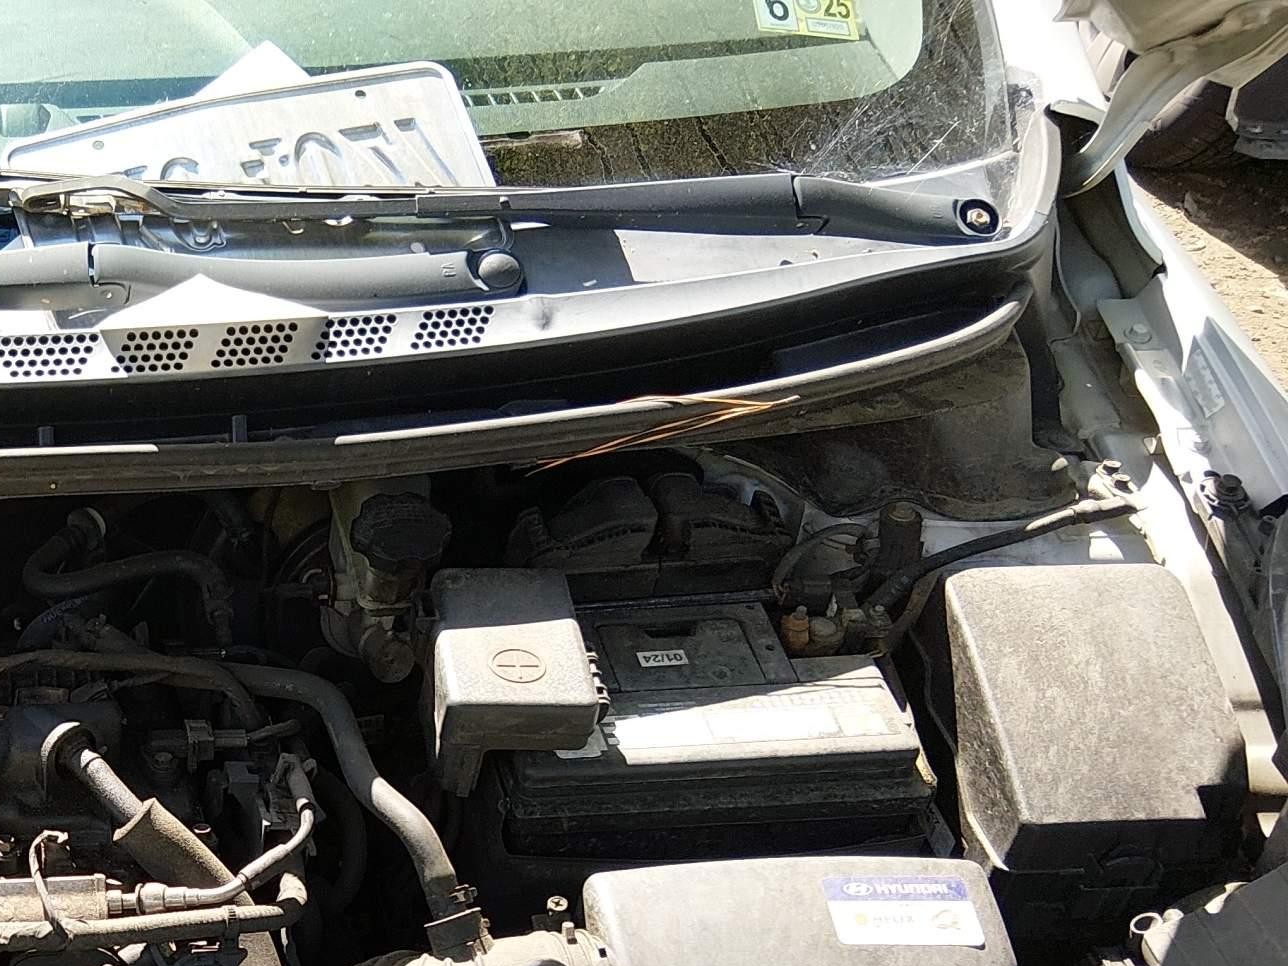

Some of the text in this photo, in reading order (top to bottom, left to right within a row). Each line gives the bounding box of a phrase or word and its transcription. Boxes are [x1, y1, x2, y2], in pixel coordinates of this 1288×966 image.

[765, 0, 850, 20] 6 25
[643, 652, 683, 663] 01/24
